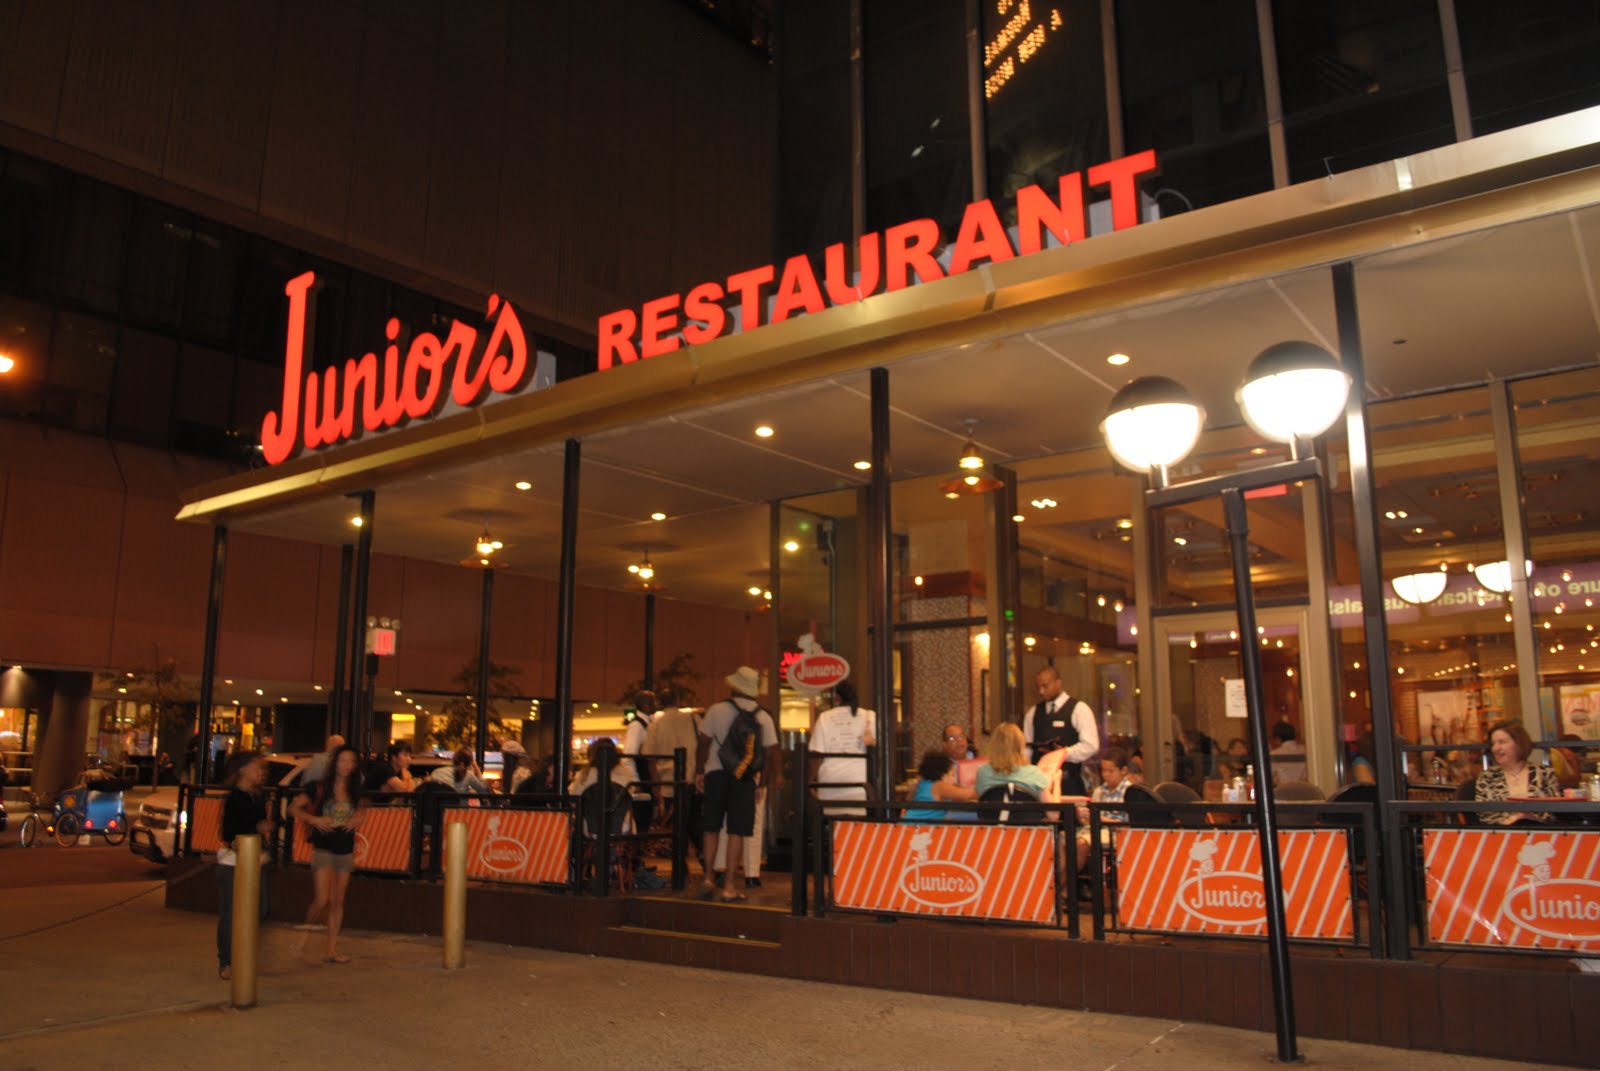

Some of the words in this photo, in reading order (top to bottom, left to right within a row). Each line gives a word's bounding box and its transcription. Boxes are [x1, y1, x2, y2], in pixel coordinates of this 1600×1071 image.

[261, 271, 528, 465] Junior's
[598, 149, 1157, 371] RESTAURANT
[797, 658, 844, 680] Juniors
[909, 856, 976, 893] Junior's
[1191, 867, 1266, 909] Junior
